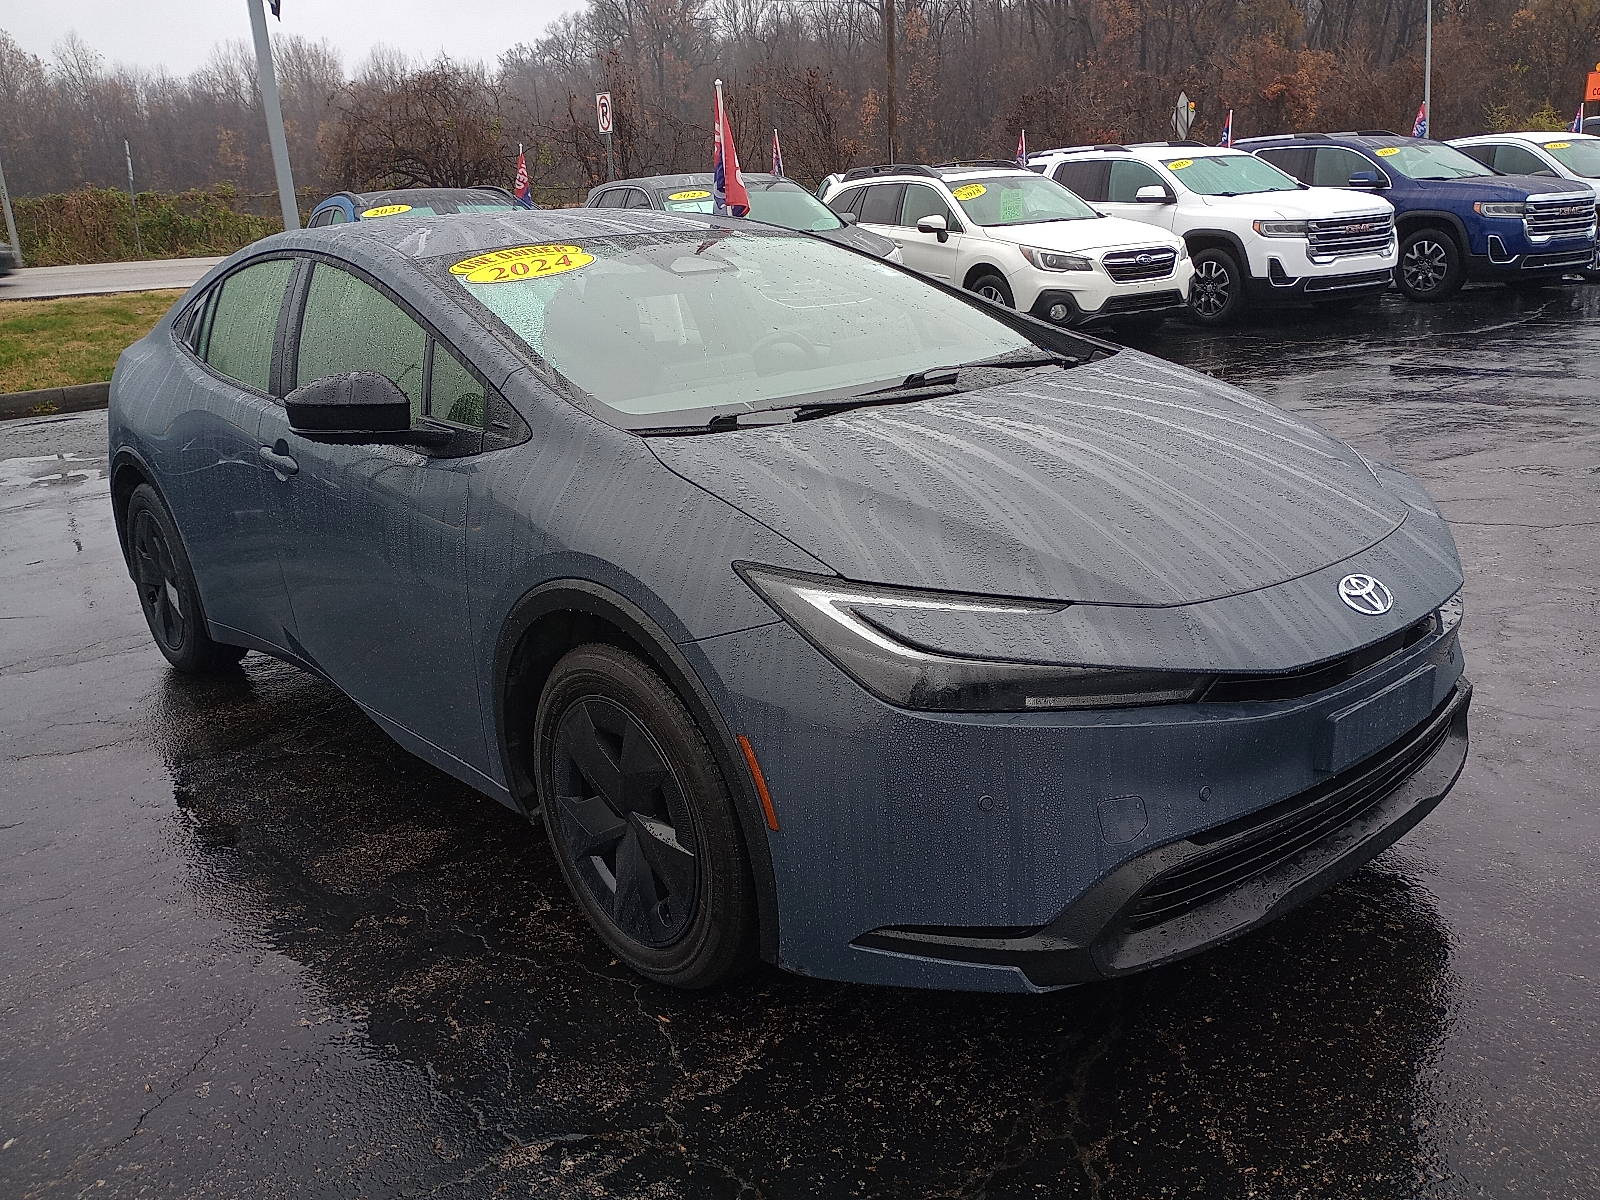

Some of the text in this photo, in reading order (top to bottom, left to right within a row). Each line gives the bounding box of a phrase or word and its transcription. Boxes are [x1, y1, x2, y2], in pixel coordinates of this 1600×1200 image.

[372, 206, 402, 216] 2021
[457, 246, 568, 270] ONE OWNER
[488, 254, 573, 281] 2024
